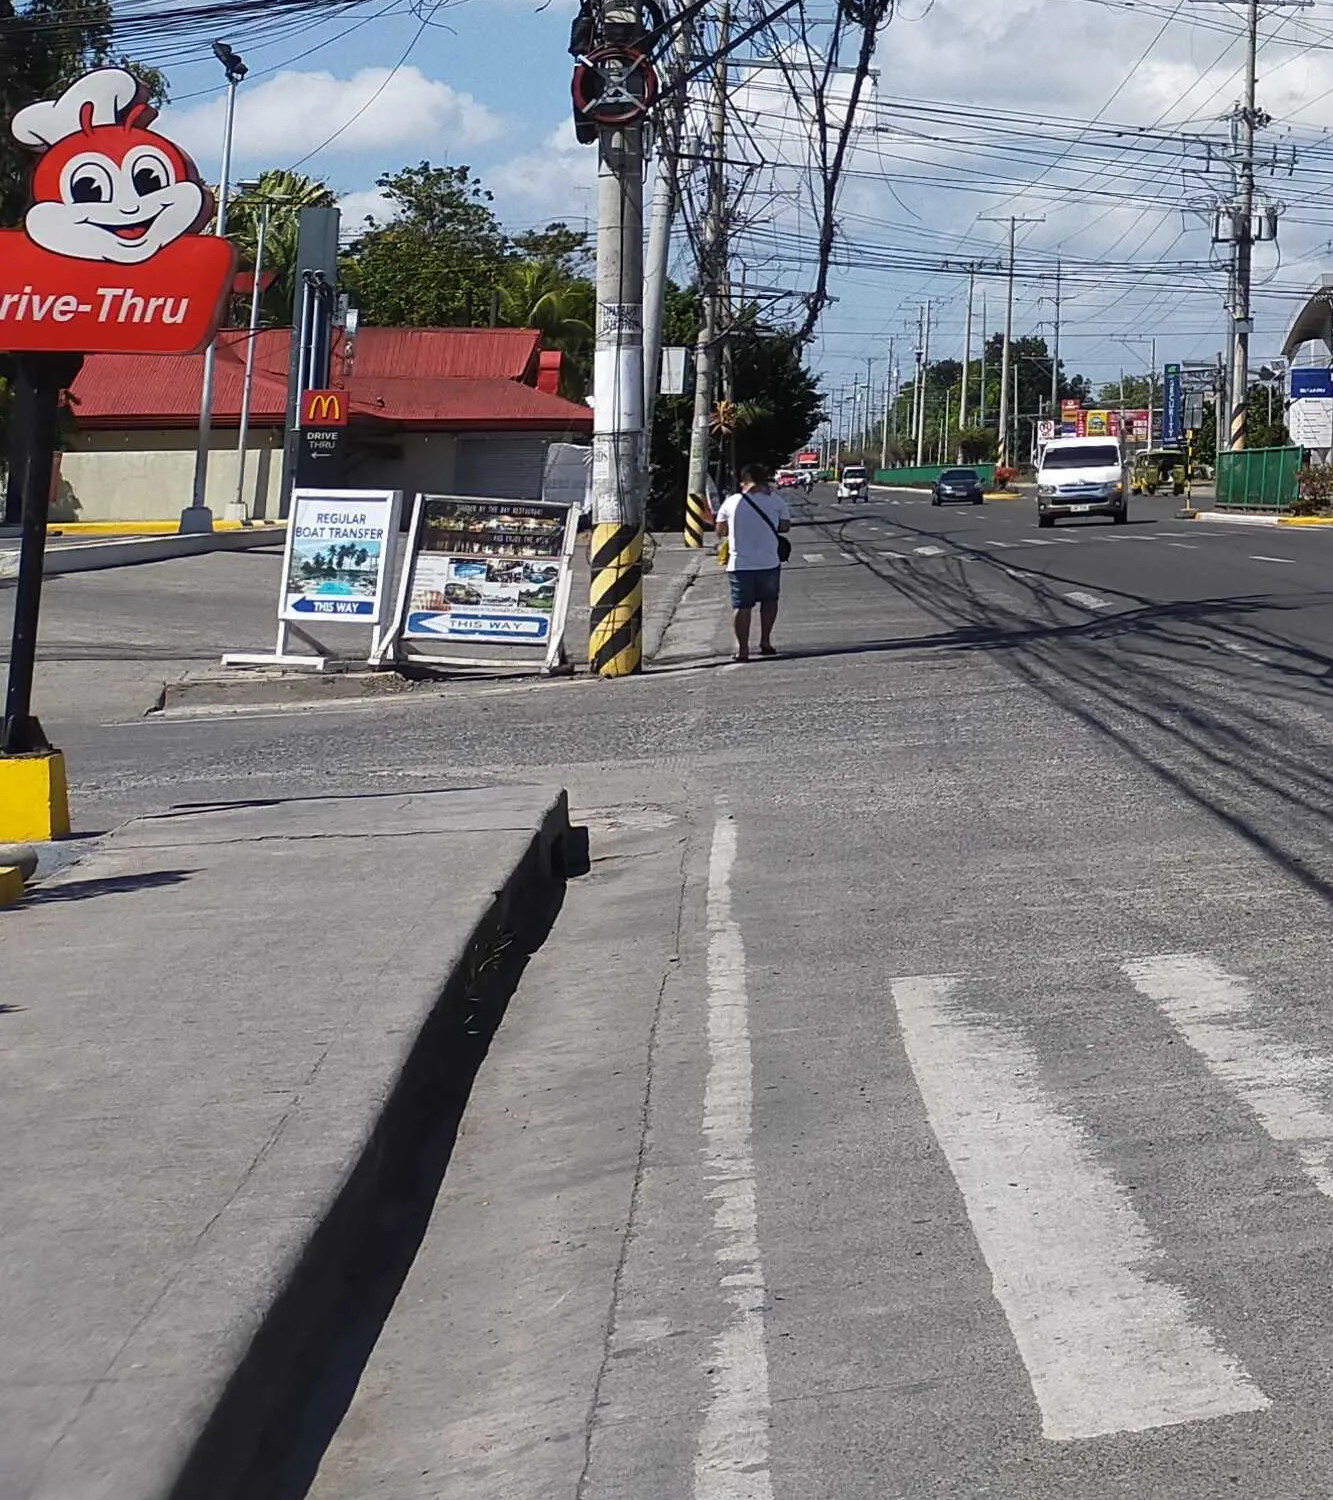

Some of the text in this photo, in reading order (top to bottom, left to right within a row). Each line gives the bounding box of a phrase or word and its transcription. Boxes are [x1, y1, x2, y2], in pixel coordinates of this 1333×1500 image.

[0, 286, 190, 324] rive-Thru
[307, 432, 339, 440] DRIVE
[309, 441, 336, 449] THRU
[316, 513, 367, 525] REGULAR
[295, 527, 384, 540] BOAT TRANSFER
[313, 602, 360, 613] THIS WAY
[450, 618, 523, 630] THIS WAY
